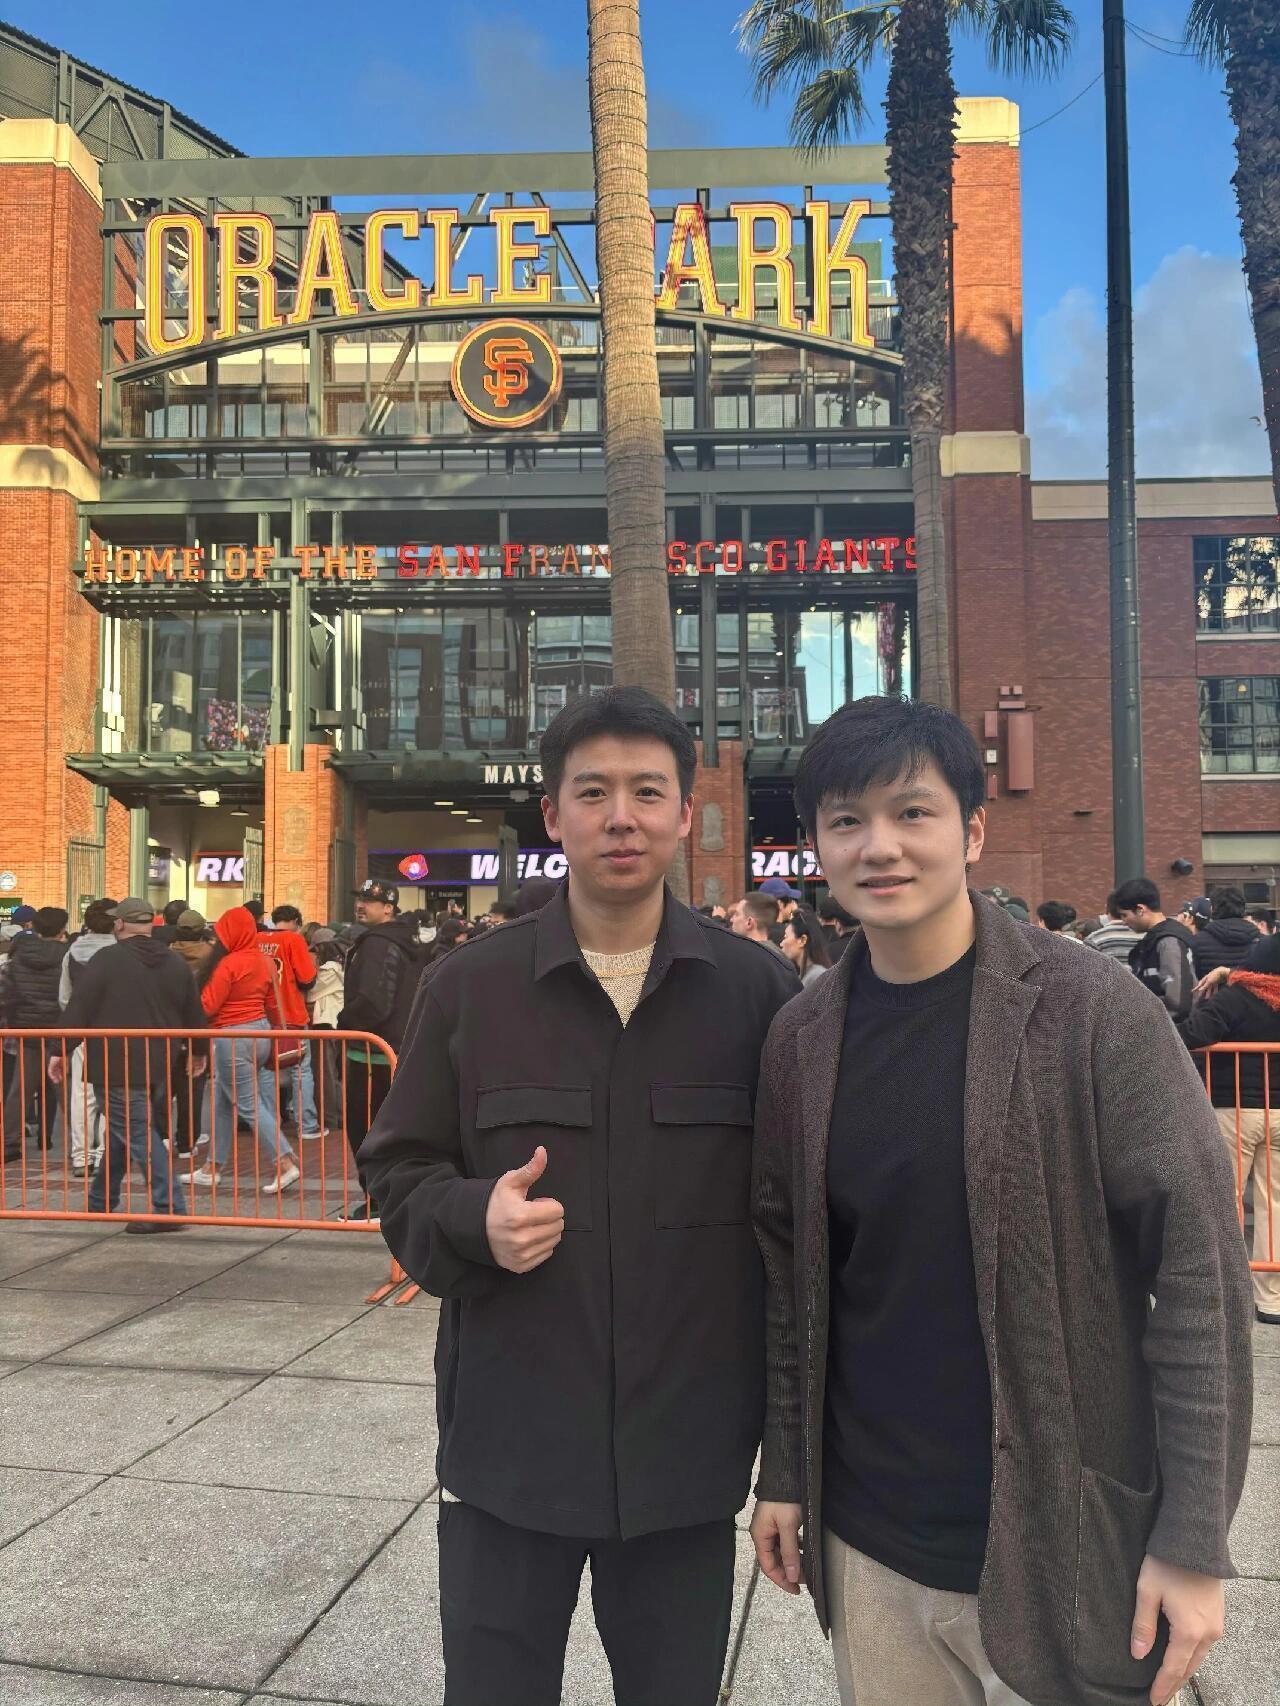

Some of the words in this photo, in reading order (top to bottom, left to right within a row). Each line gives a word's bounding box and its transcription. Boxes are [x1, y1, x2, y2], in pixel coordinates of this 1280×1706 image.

[145, 207, 552, 355] ORACLE
[650, 199, 876, 347] ARK
[84, 545, 205, 582] HOME
[224, 545, 276, 580] OF
[294, 544, 378, 580] THE
[397, 543, 482, 577] SAN
[502, 540, 743, 577] FRANSCO
[767, 537, 918, 572] GIANTS
[484, 764, 544, 784] MAYS
